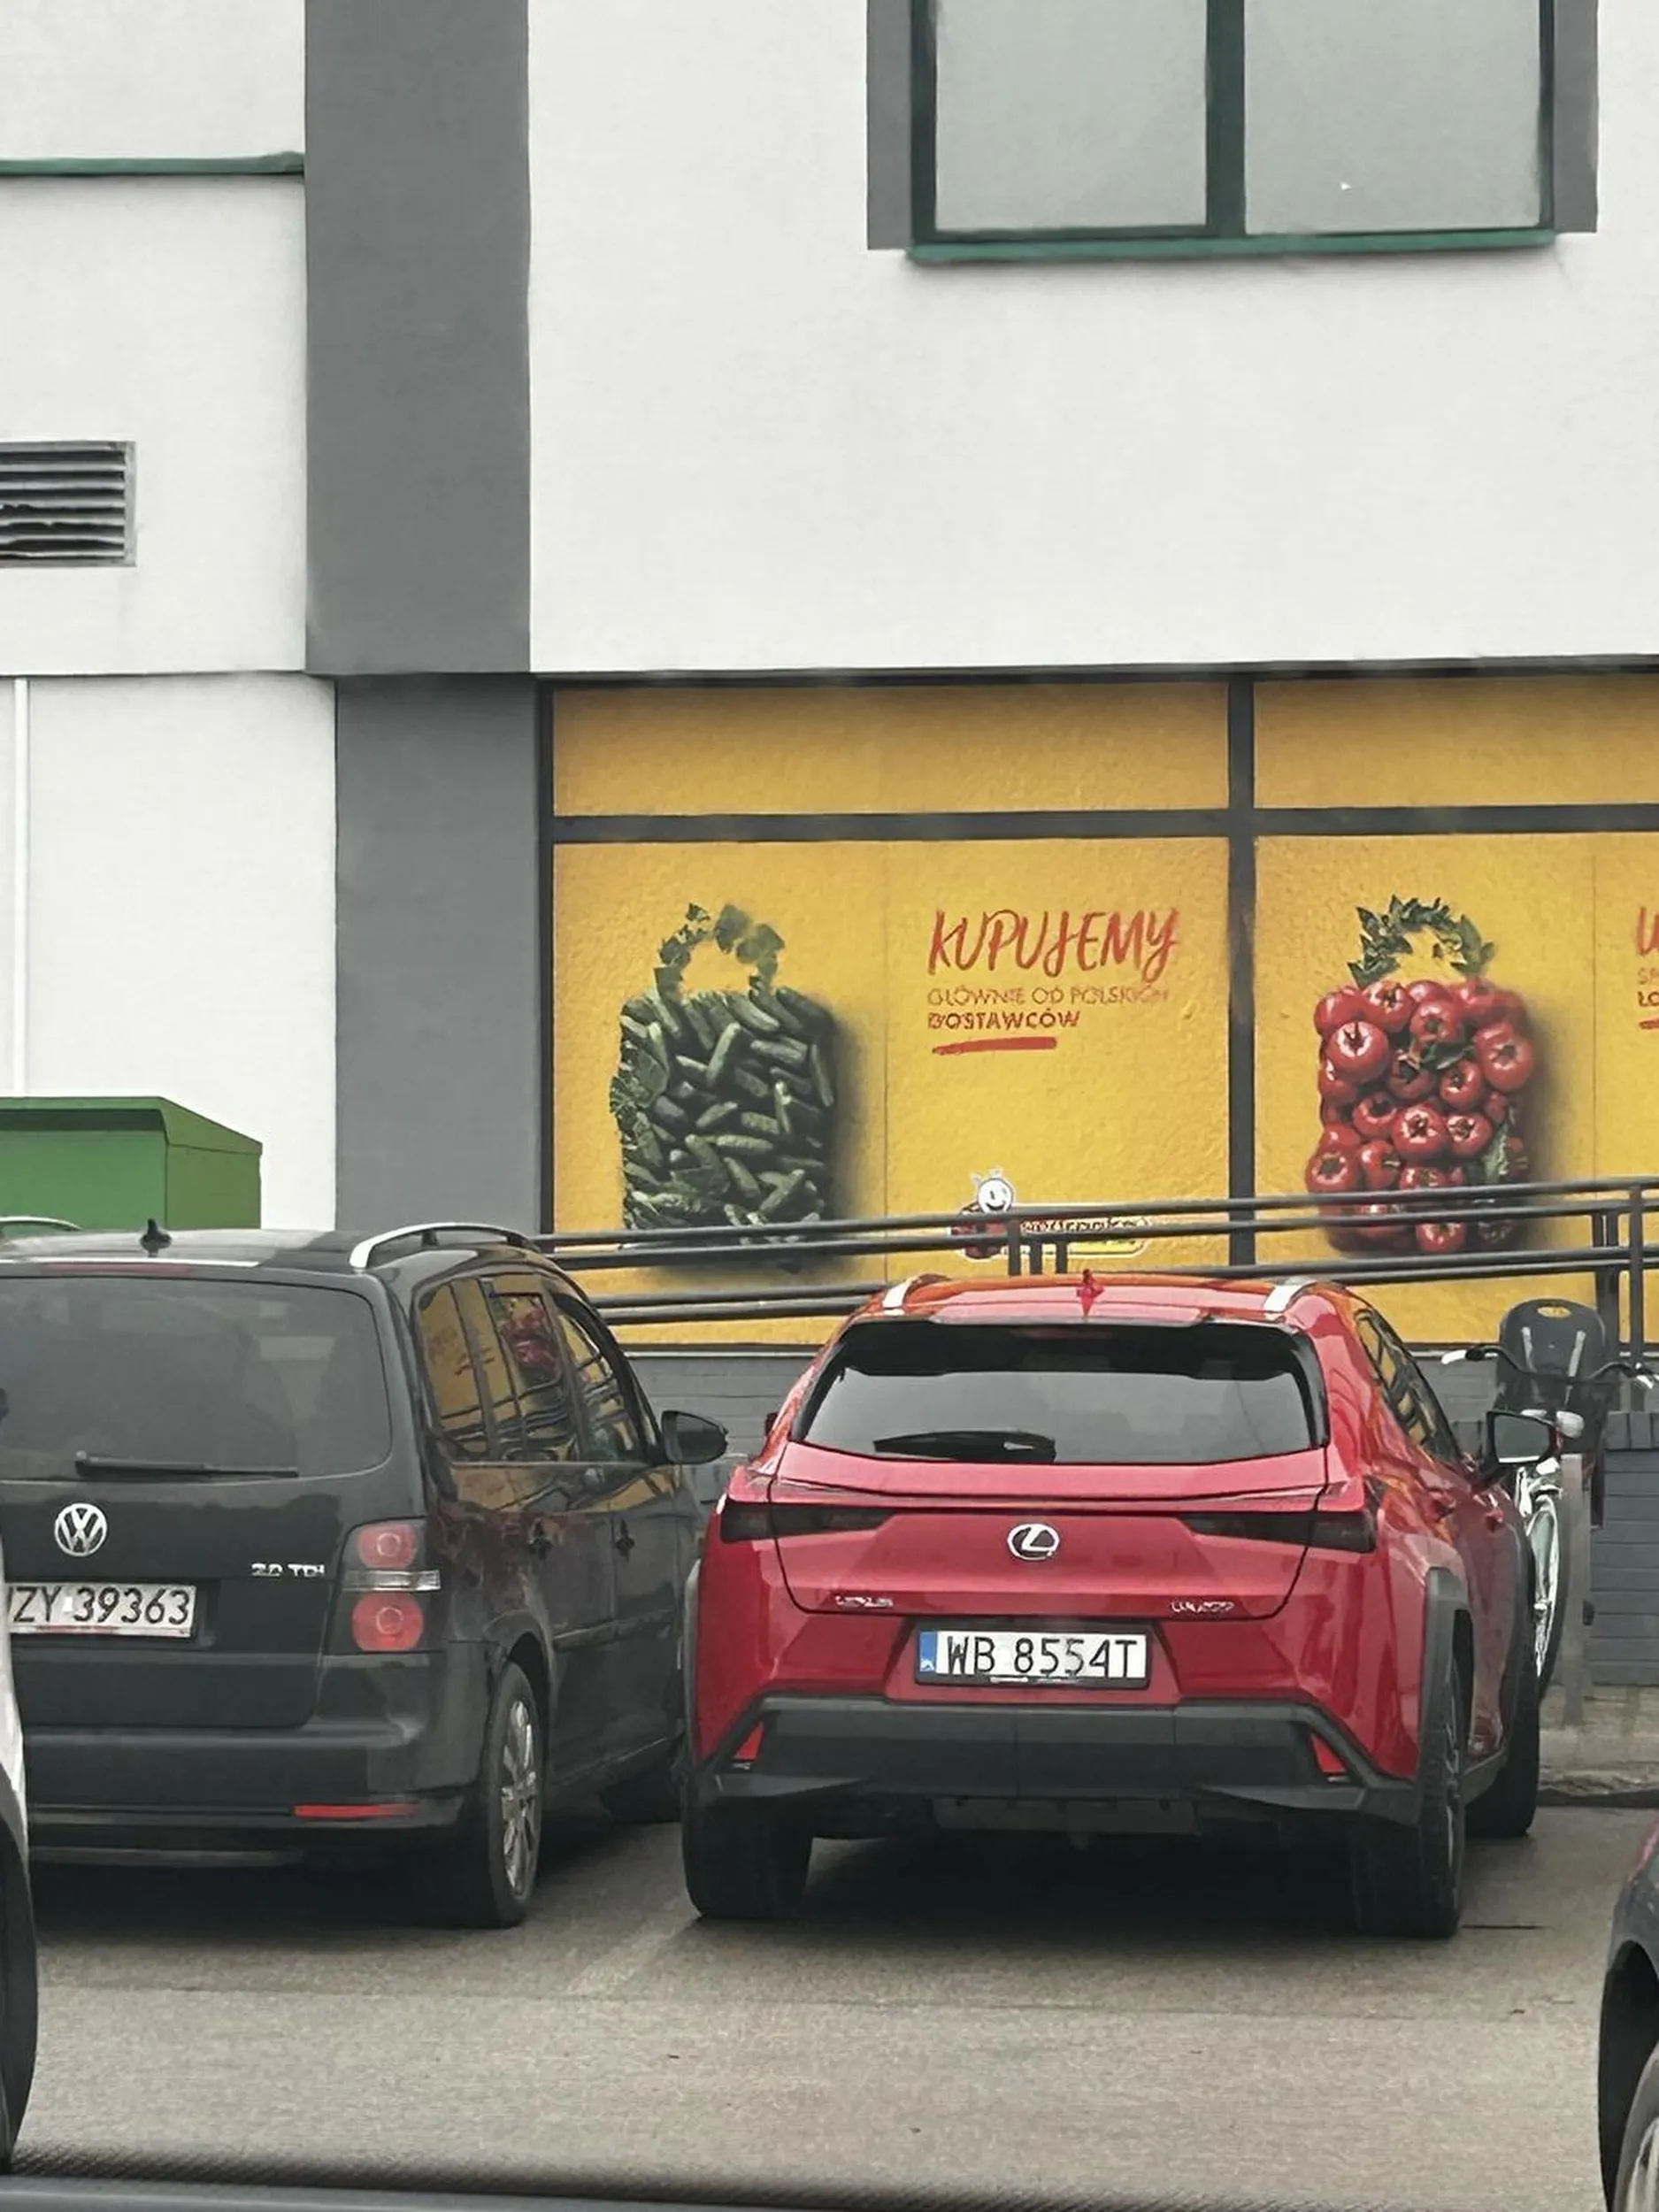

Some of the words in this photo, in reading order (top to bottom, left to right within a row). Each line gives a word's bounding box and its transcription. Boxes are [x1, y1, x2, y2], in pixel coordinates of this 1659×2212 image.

[927, 907, 1179, 983] KUPUJEMY
[1032, 987, 1064, 1005] OD
[927, 1009, 1080, 1030] DOSTAWCÓW
[287, 1563, 325, 1578] TDI
[7, 1586, 62, 1623] ZY
[73, 1586, 190, 1625] 39363
[947, 1635, 995, 1676] WB
[1013, 1637, 1138, 1678] 8554T
